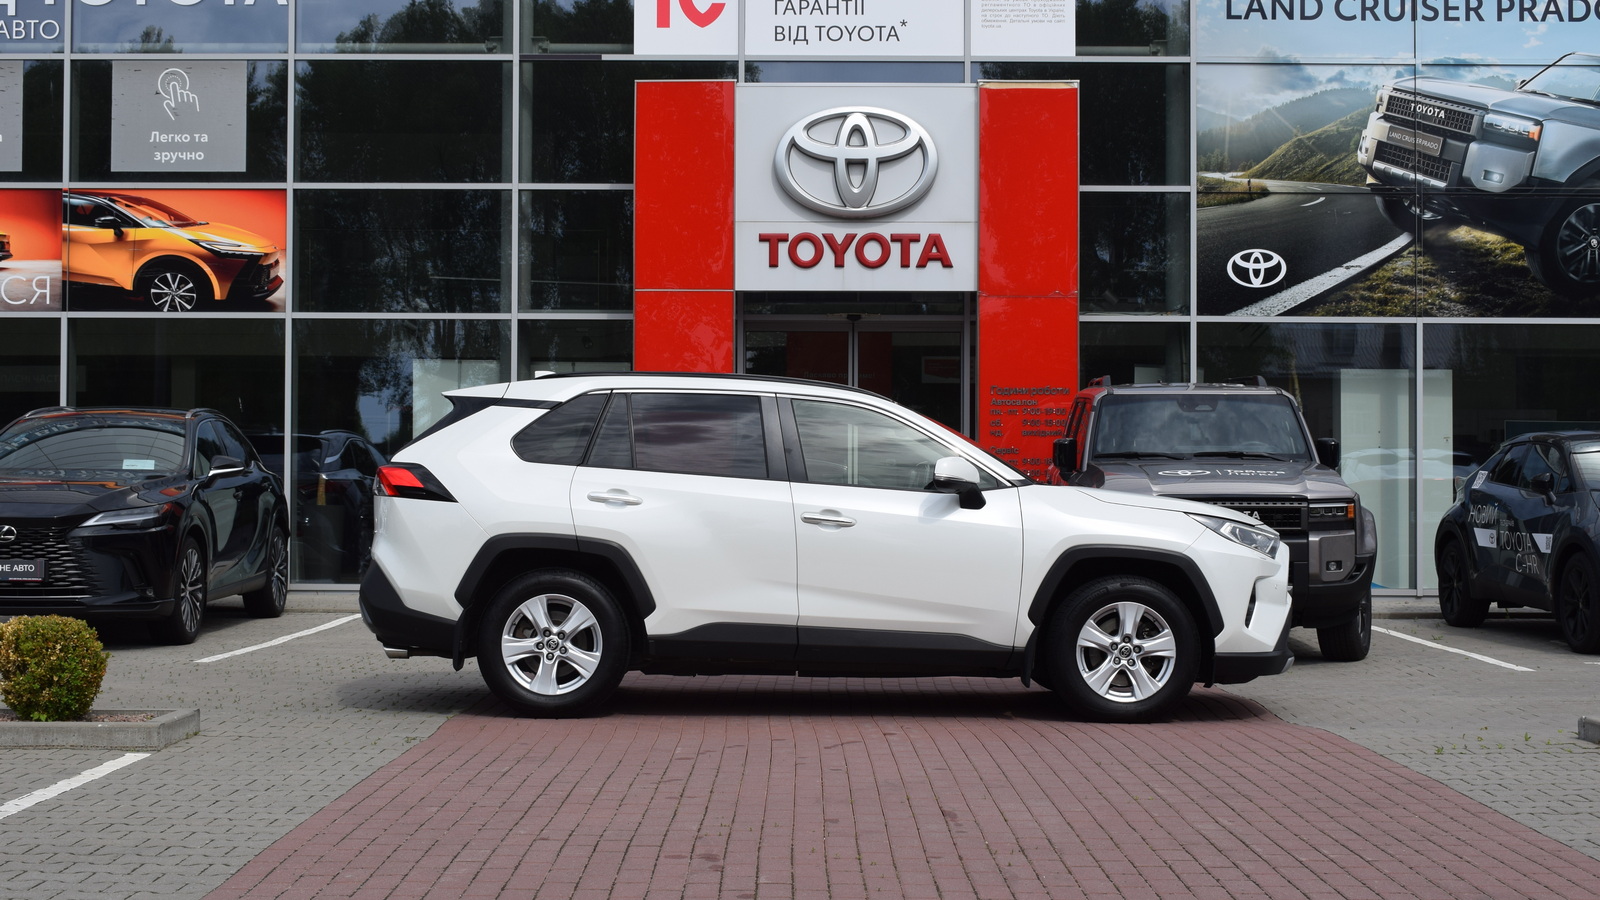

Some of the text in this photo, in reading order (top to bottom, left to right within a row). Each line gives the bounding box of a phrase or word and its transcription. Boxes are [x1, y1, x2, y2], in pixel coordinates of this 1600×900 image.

[1226, 0, 1323, 21] LAND
[1334, 0, 1485, 22] CRUISER
[774, 26, 809, 45] ВІД
[1410, 104, 1445, 118] TOYOTA
[150, 131, 208, 142] Легко та
[1389, 132, 1401, 140] LAND
[1422, 140, 1438, 150] PRADO
[154, 151, 204, 163] зручно
[758, 232, 954, 268] TOYOTA
[990, 385, 1070, 396] Години роботи
[990, 446, 1019, 455] Сервіс
[1468, 502, 1498, 524] НОВИЙ
[1500, 531, 1533, 552] TOYOTA
[1516, 554, 1539, 574] C-HR
